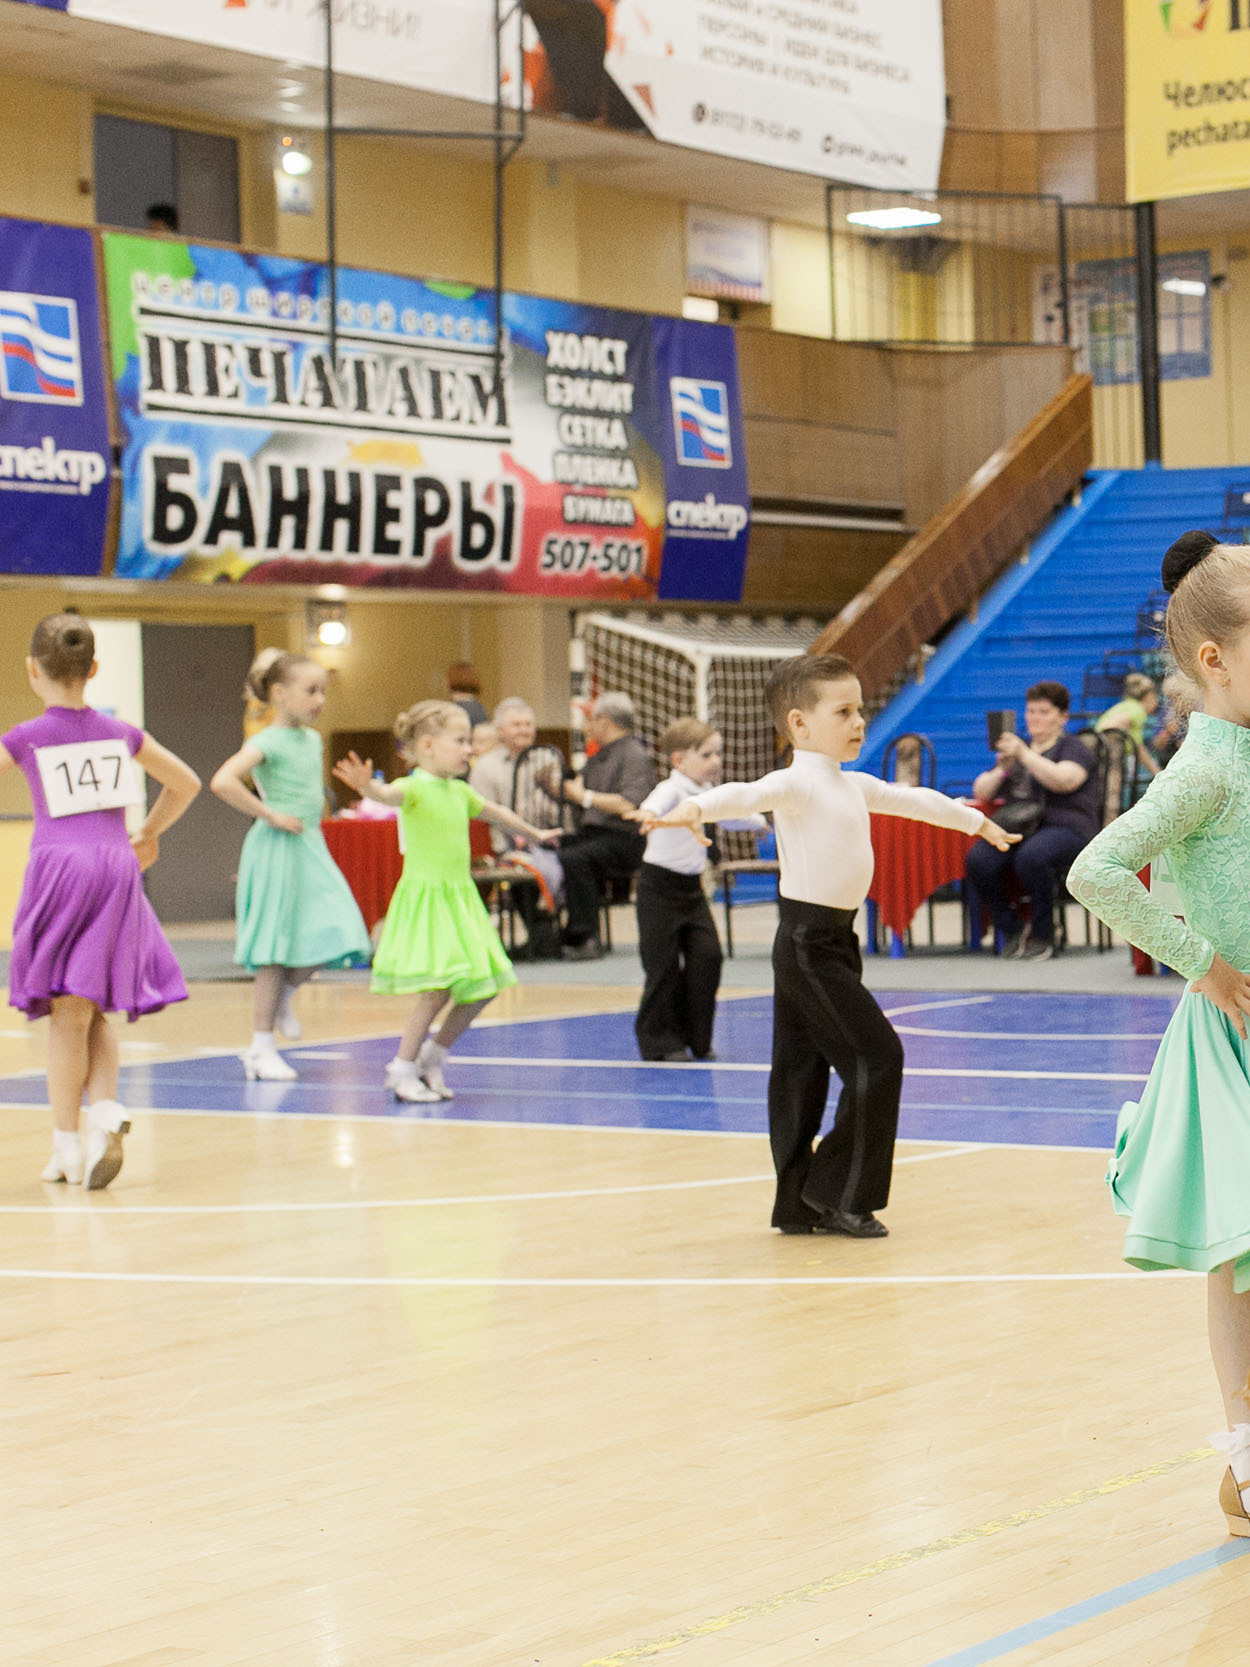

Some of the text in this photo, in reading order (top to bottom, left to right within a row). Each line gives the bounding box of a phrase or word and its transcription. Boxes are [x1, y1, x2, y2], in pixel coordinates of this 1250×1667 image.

[545, 330, 628, 375] ХОЛСТ
[143, 334, 510, 427] ПЕЧАТАЕМ
[560, 413, 629, 450] СЕТКА
[0, 435, 107, 496] пектр
[150, 454, 516, 563] БАННЕРЫ
[541, 537, 644, 575] 507-501
[55, 755, 122, 795] 147
